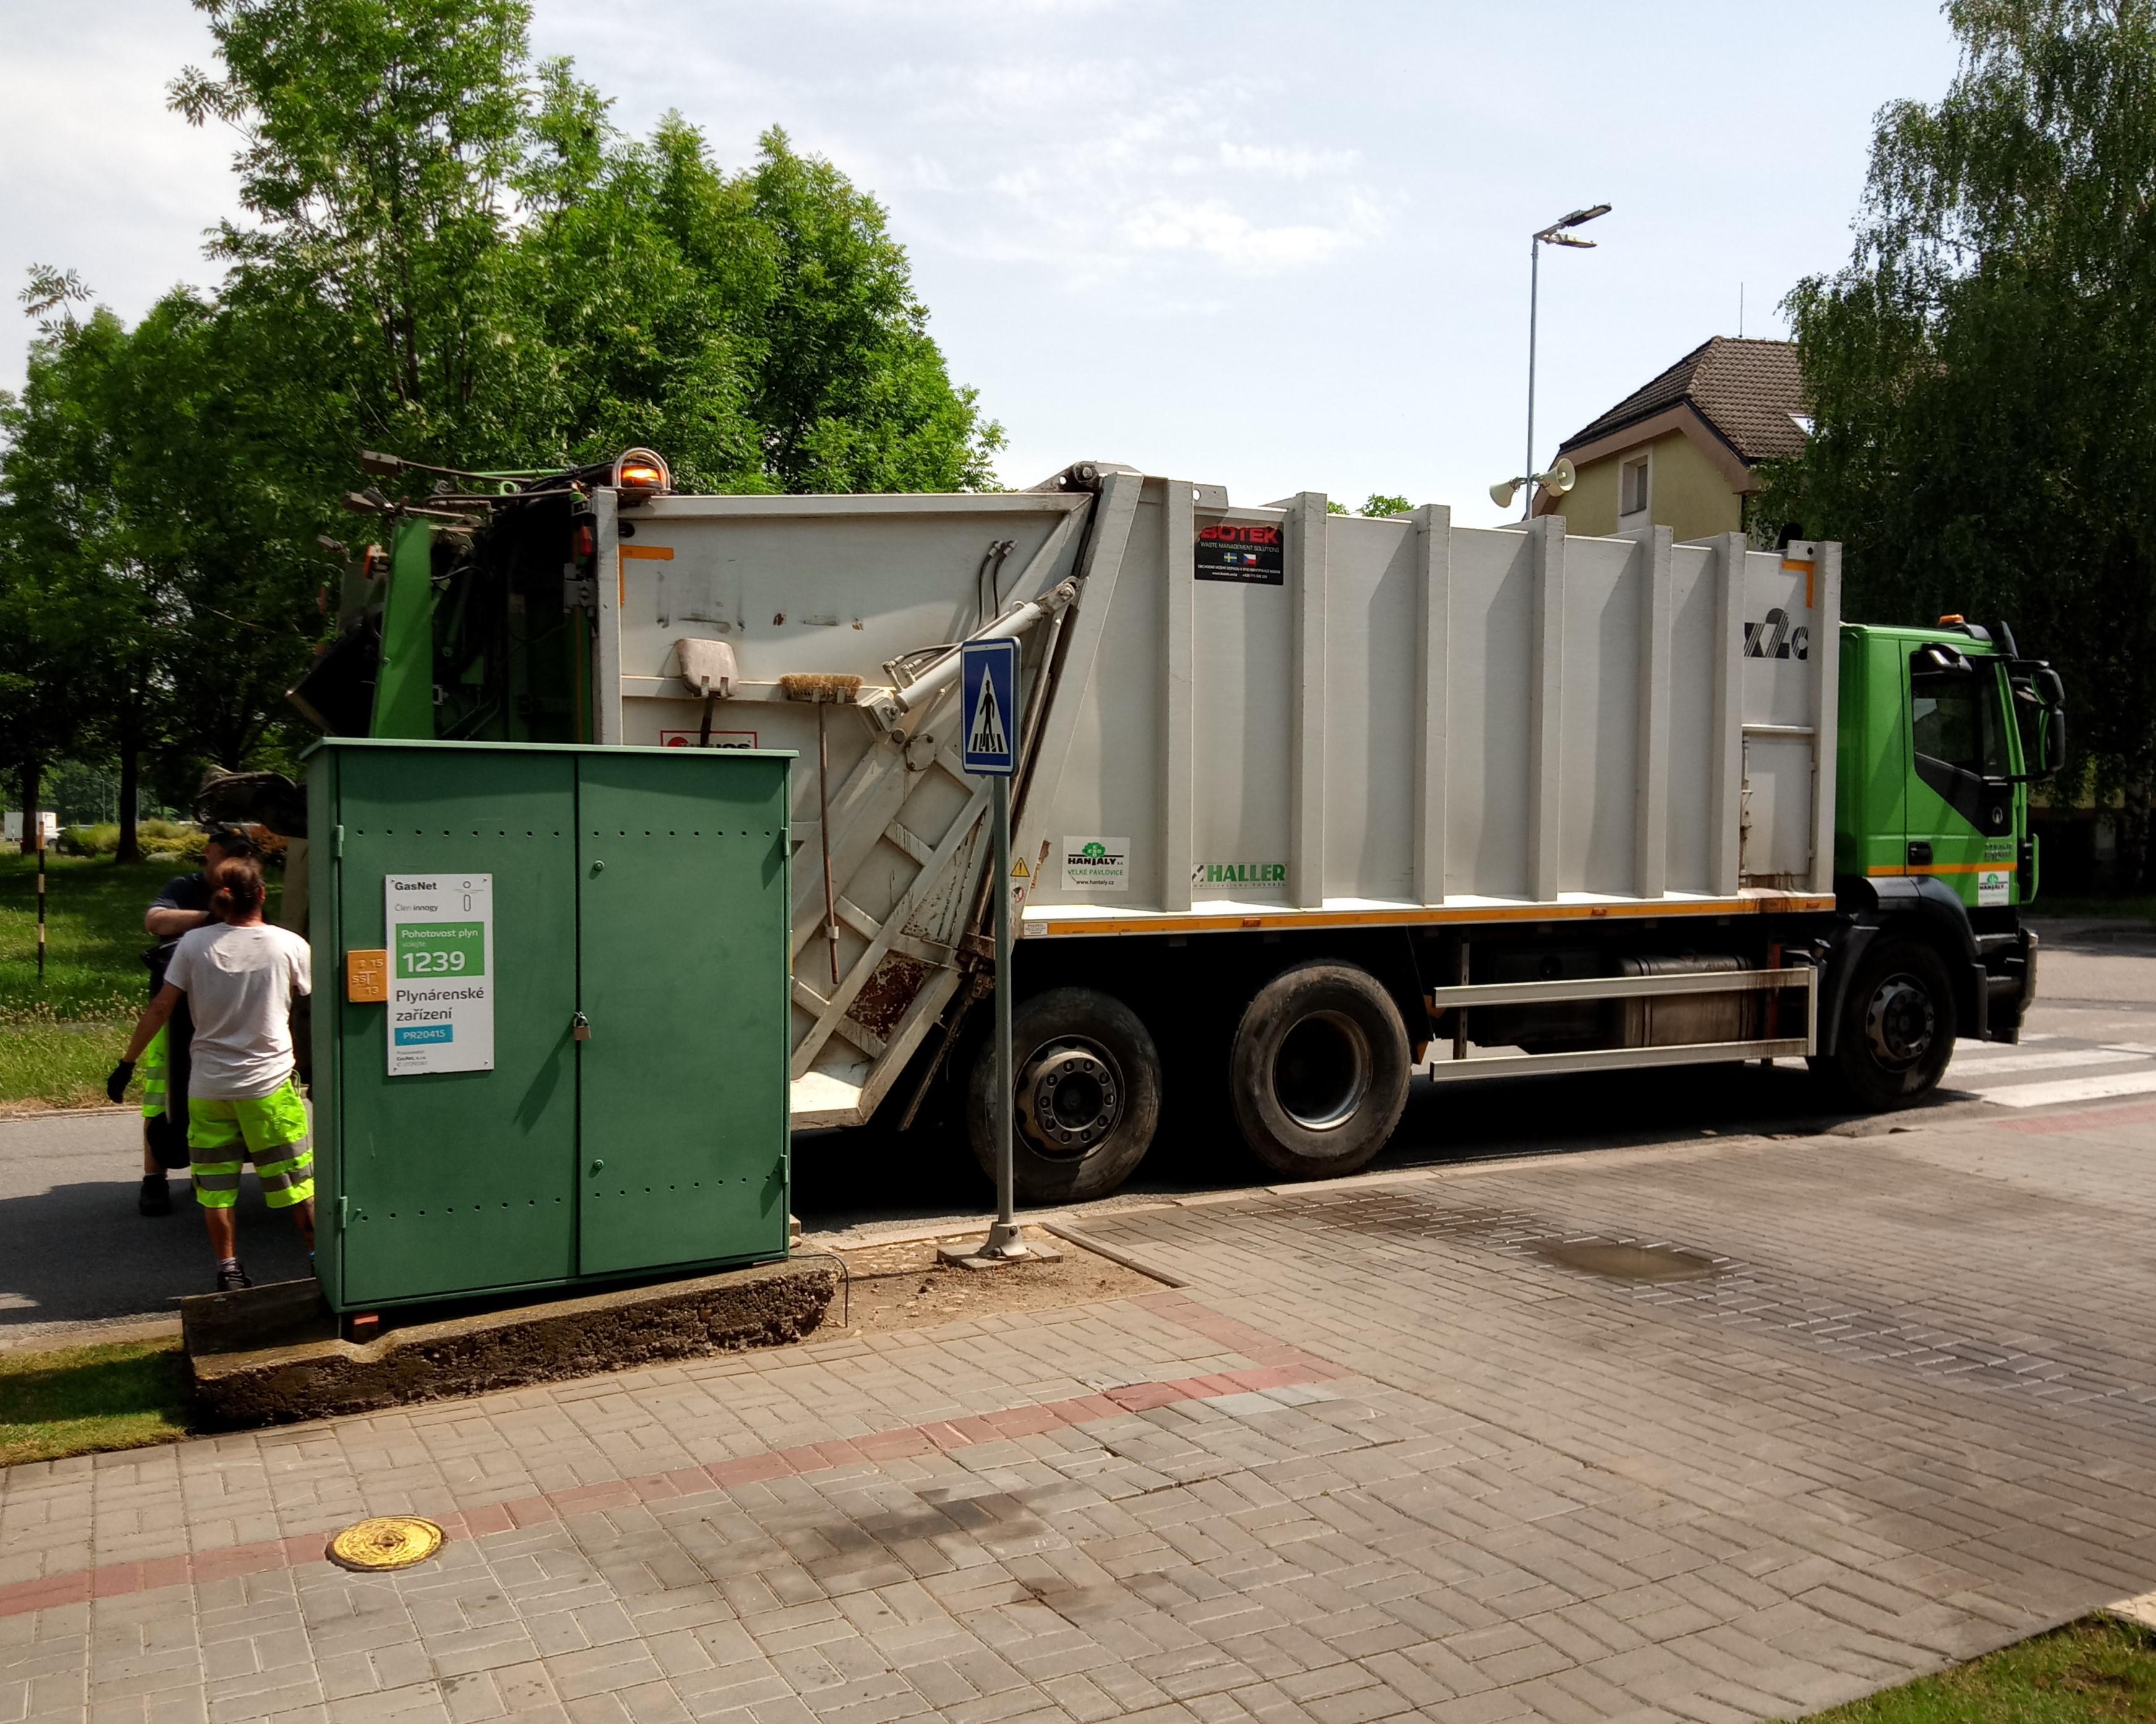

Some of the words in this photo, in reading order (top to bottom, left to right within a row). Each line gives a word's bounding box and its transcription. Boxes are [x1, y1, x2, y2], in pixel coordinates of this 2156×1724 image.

[1219, 543, 1253, 551] MANAGEMENT
[1207, 864, 1285, 882] HALLER
[395, 882, 437, 891] GasNet
[402, 929, 456, 938] Pohotovost
[458, 928, 478, 938] plyn
[403, 951, 466, 972] 1239
[396, 987, 484, 1005] Plynárenské
[396, 1007, 453, 1021] zařízení
[403, 1030, 445, 1039] PR20415
